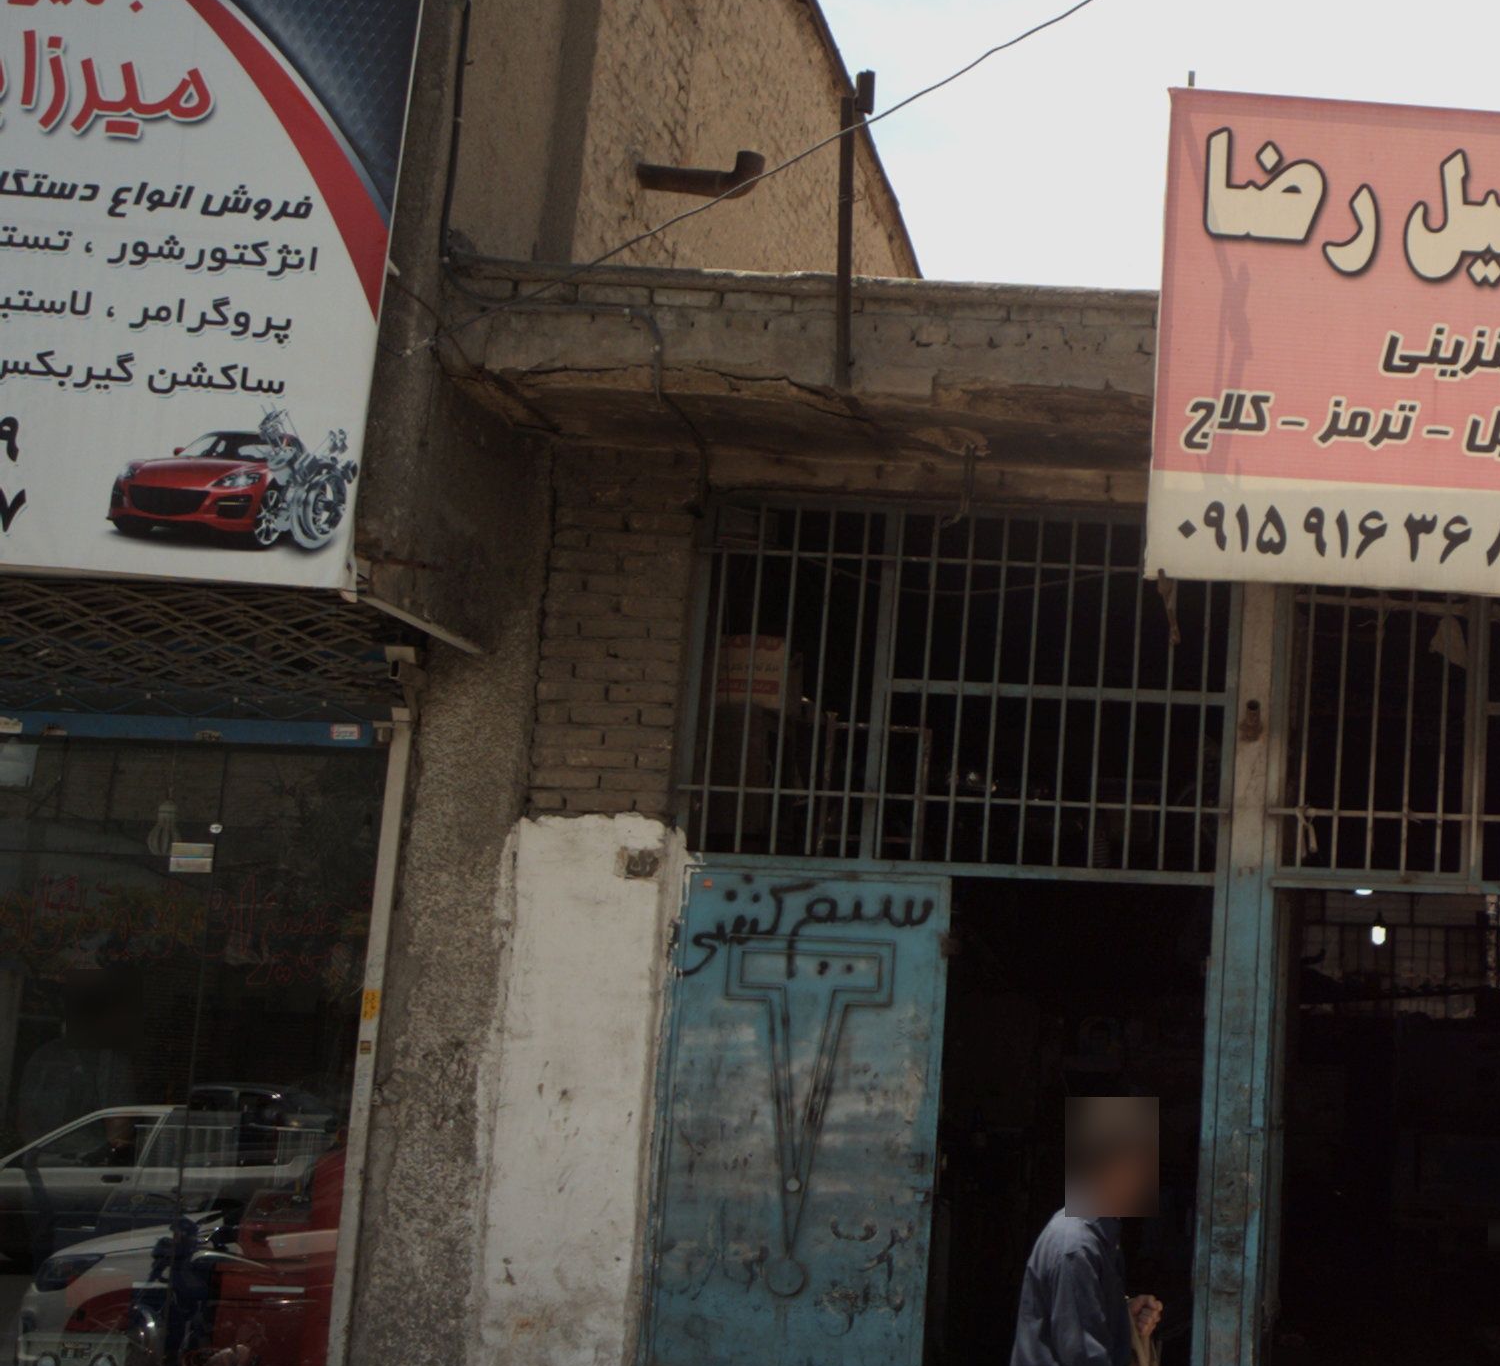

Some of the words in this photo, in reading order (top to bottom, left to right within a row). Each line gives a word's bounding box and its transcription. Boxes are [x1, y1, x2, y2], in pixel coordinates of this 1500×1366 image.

[0, 29, 213, 136] میرزا
[107, 182, 195, 218] انواع
[201, 183, 314, 220] فروش
[1203, 126, 1381, 278] رضا
[148, 360, 286, 395] ساکشن
[1319, 399, 1418, 448] ترمز
[1177, 500, 1288, 556] ۰۹۱۵
[1303, 506, 1389, 560] ۹۱۶
[1403, 512, 1473, 564] ۳۶
[786, 896, 937, 981] سیم
